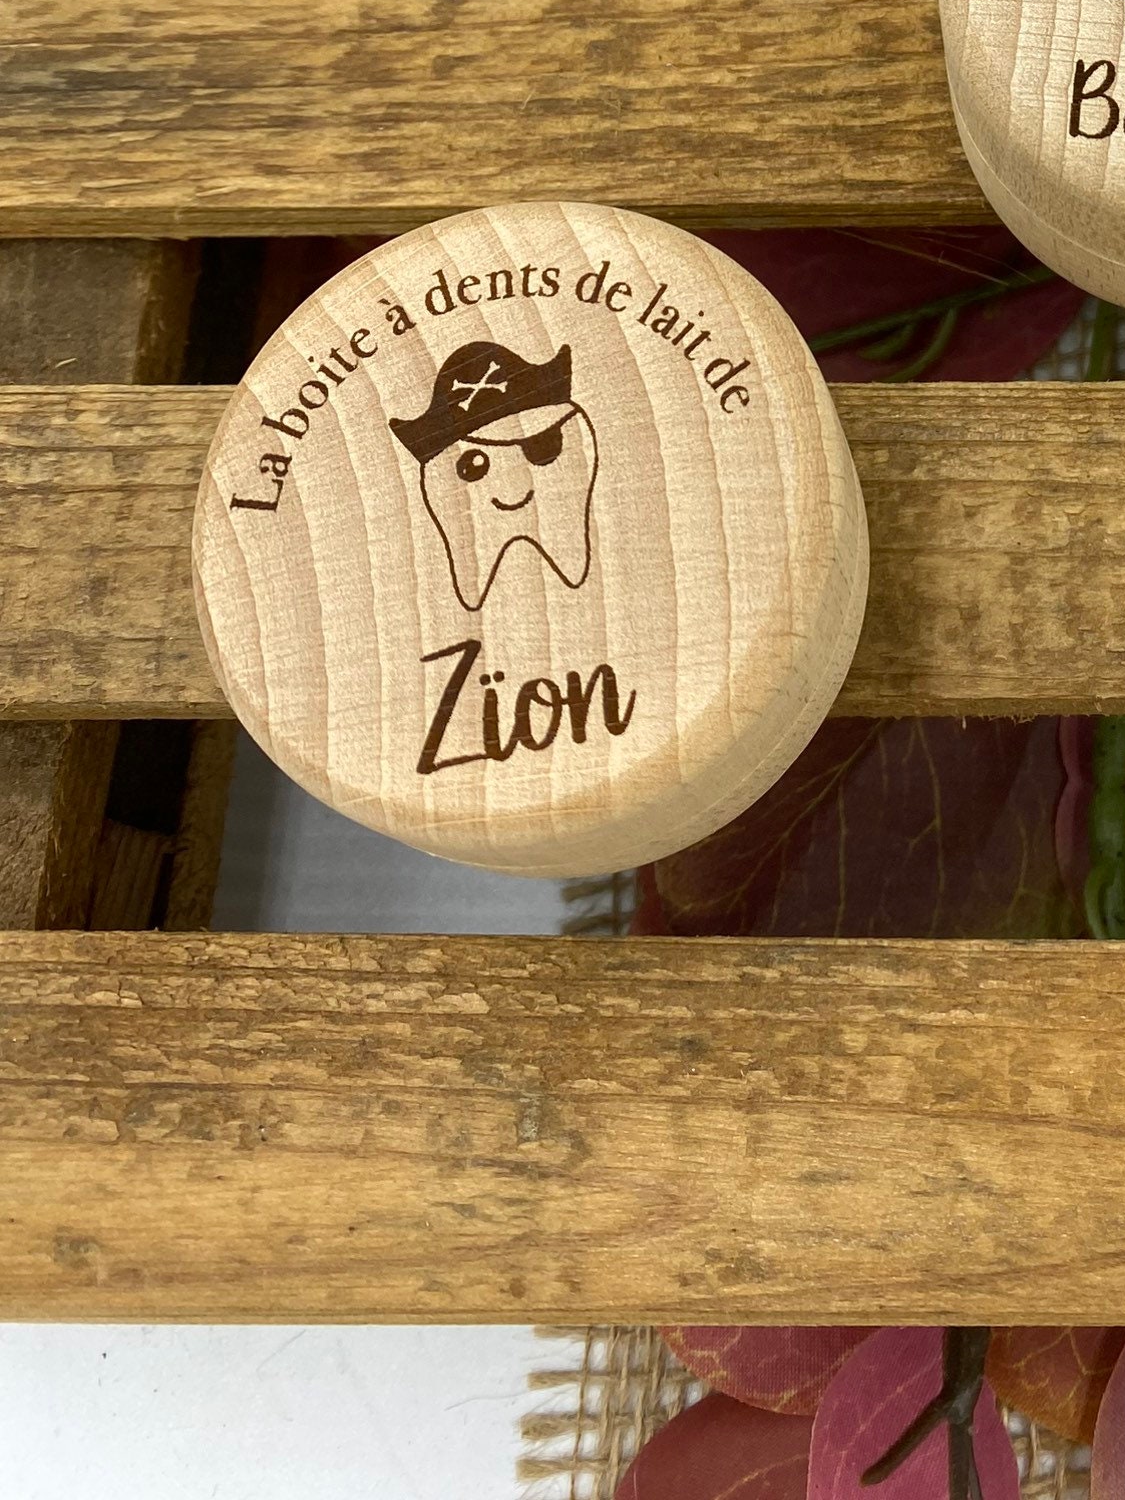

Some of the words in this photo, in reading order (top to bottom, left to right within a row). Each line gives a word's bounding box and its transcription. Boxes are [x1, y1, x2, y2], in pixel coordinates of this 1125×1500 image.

[230, 452, 293, 513] La
[262, 325, 379, 437] boite
[379, 299, 416, 338] à
[424, 264, 560, 317] dents
[575, 260, 633, 312] de
[637, 283, 713, 362] lait
[701, 352, 752, 415] de
[416, 639, 637, 775] Zïon
